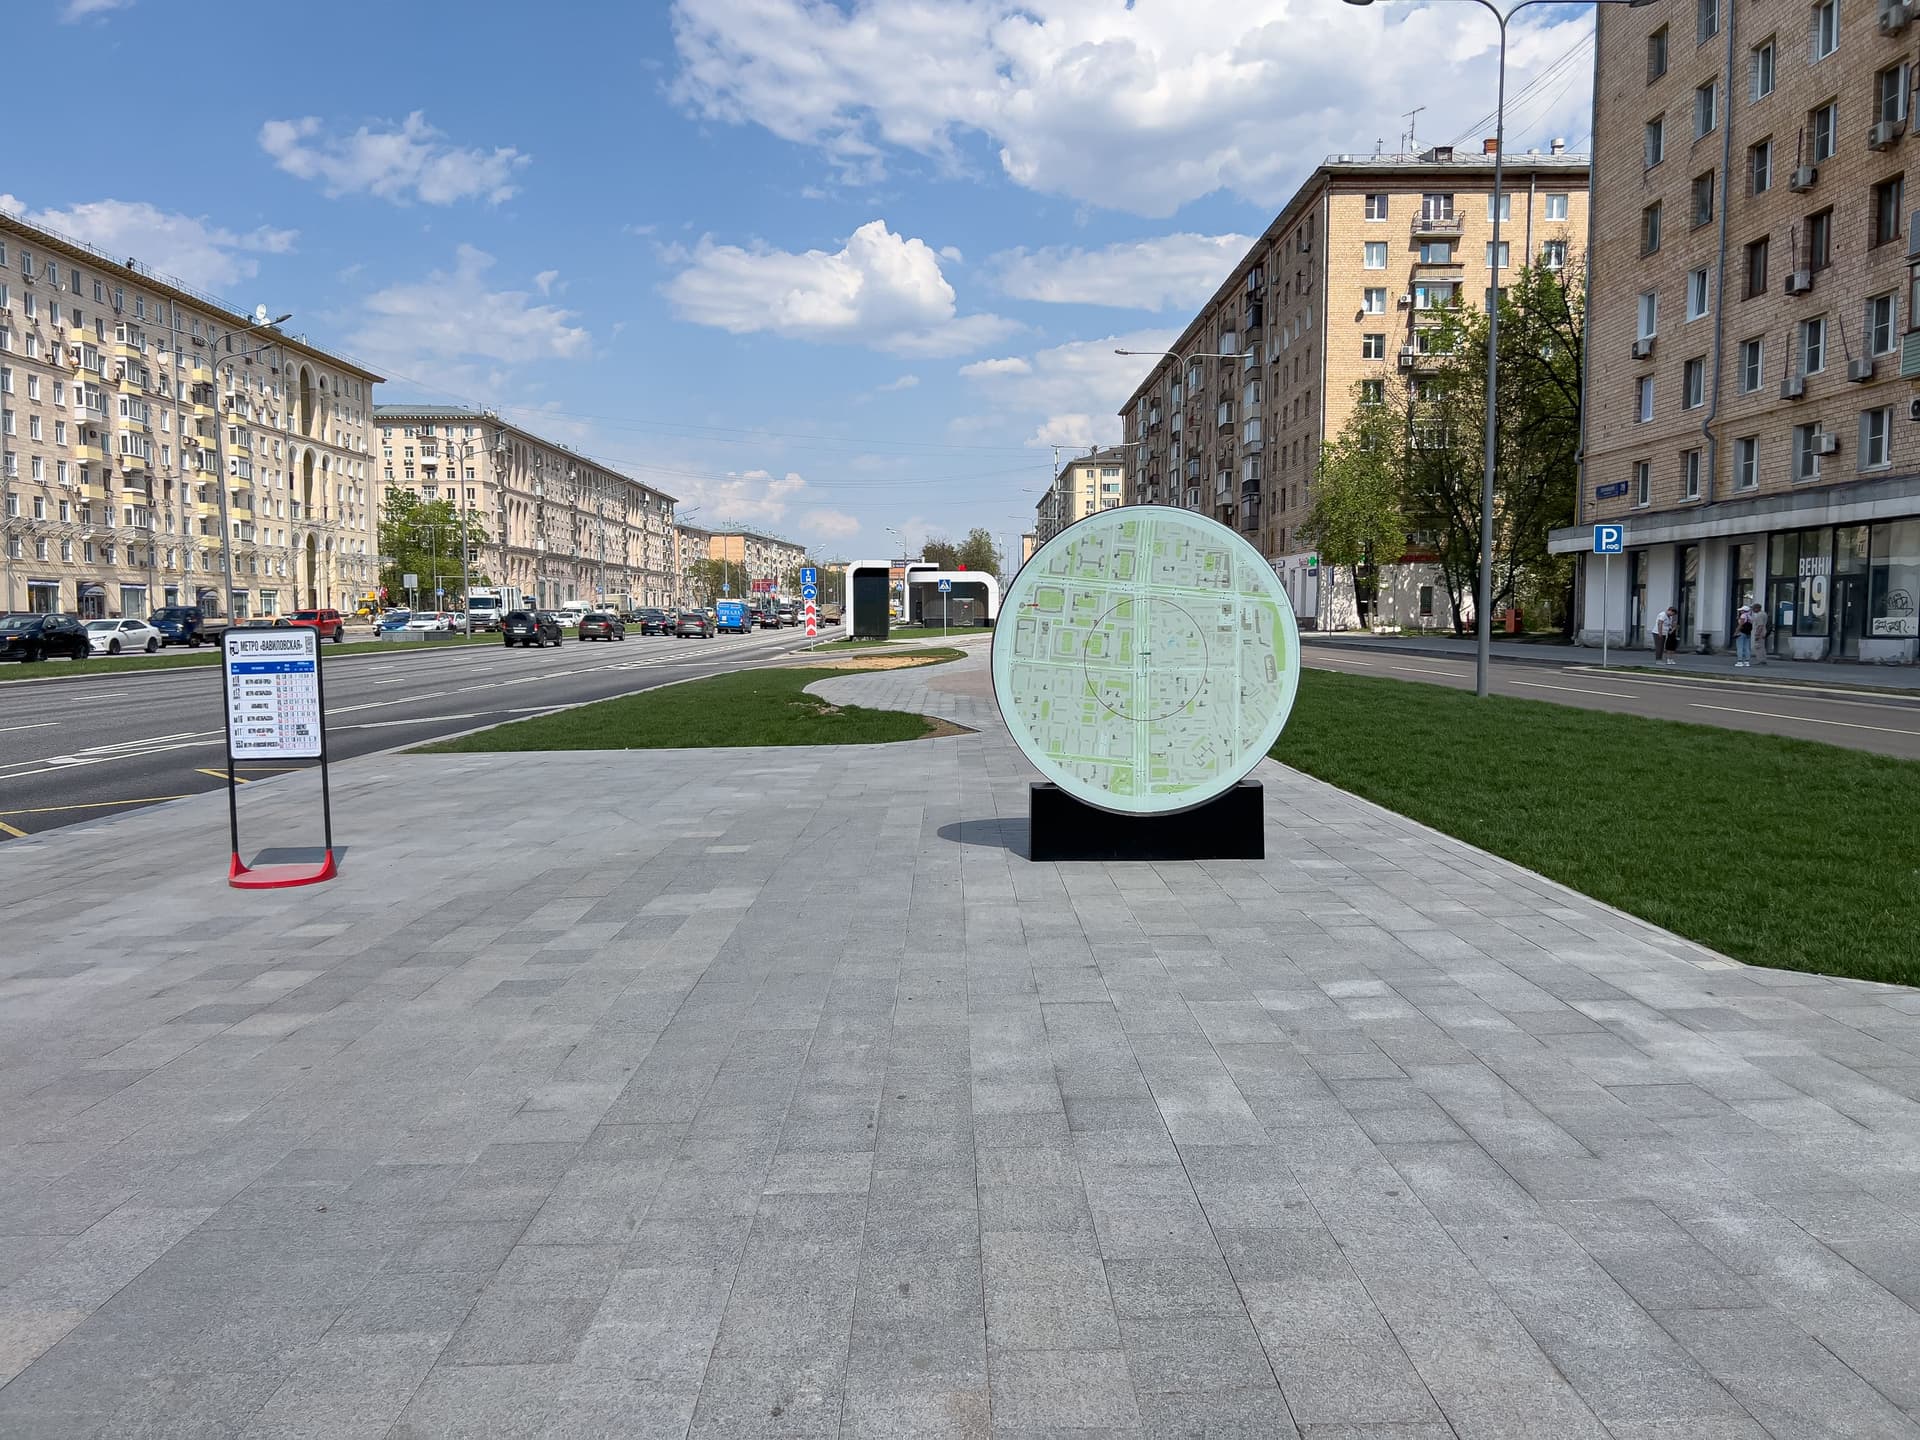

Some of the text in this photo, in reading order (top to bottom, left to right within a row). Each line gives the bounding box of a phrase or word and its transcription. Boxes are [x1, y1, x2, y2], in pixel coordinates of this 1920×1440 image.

[1602, 528, 1618, 550] P
[1800, 575, 1827, 616] 19
[240, 639, 303, 652] МЕТРО «ВАВИЛОВСКАЯ»
